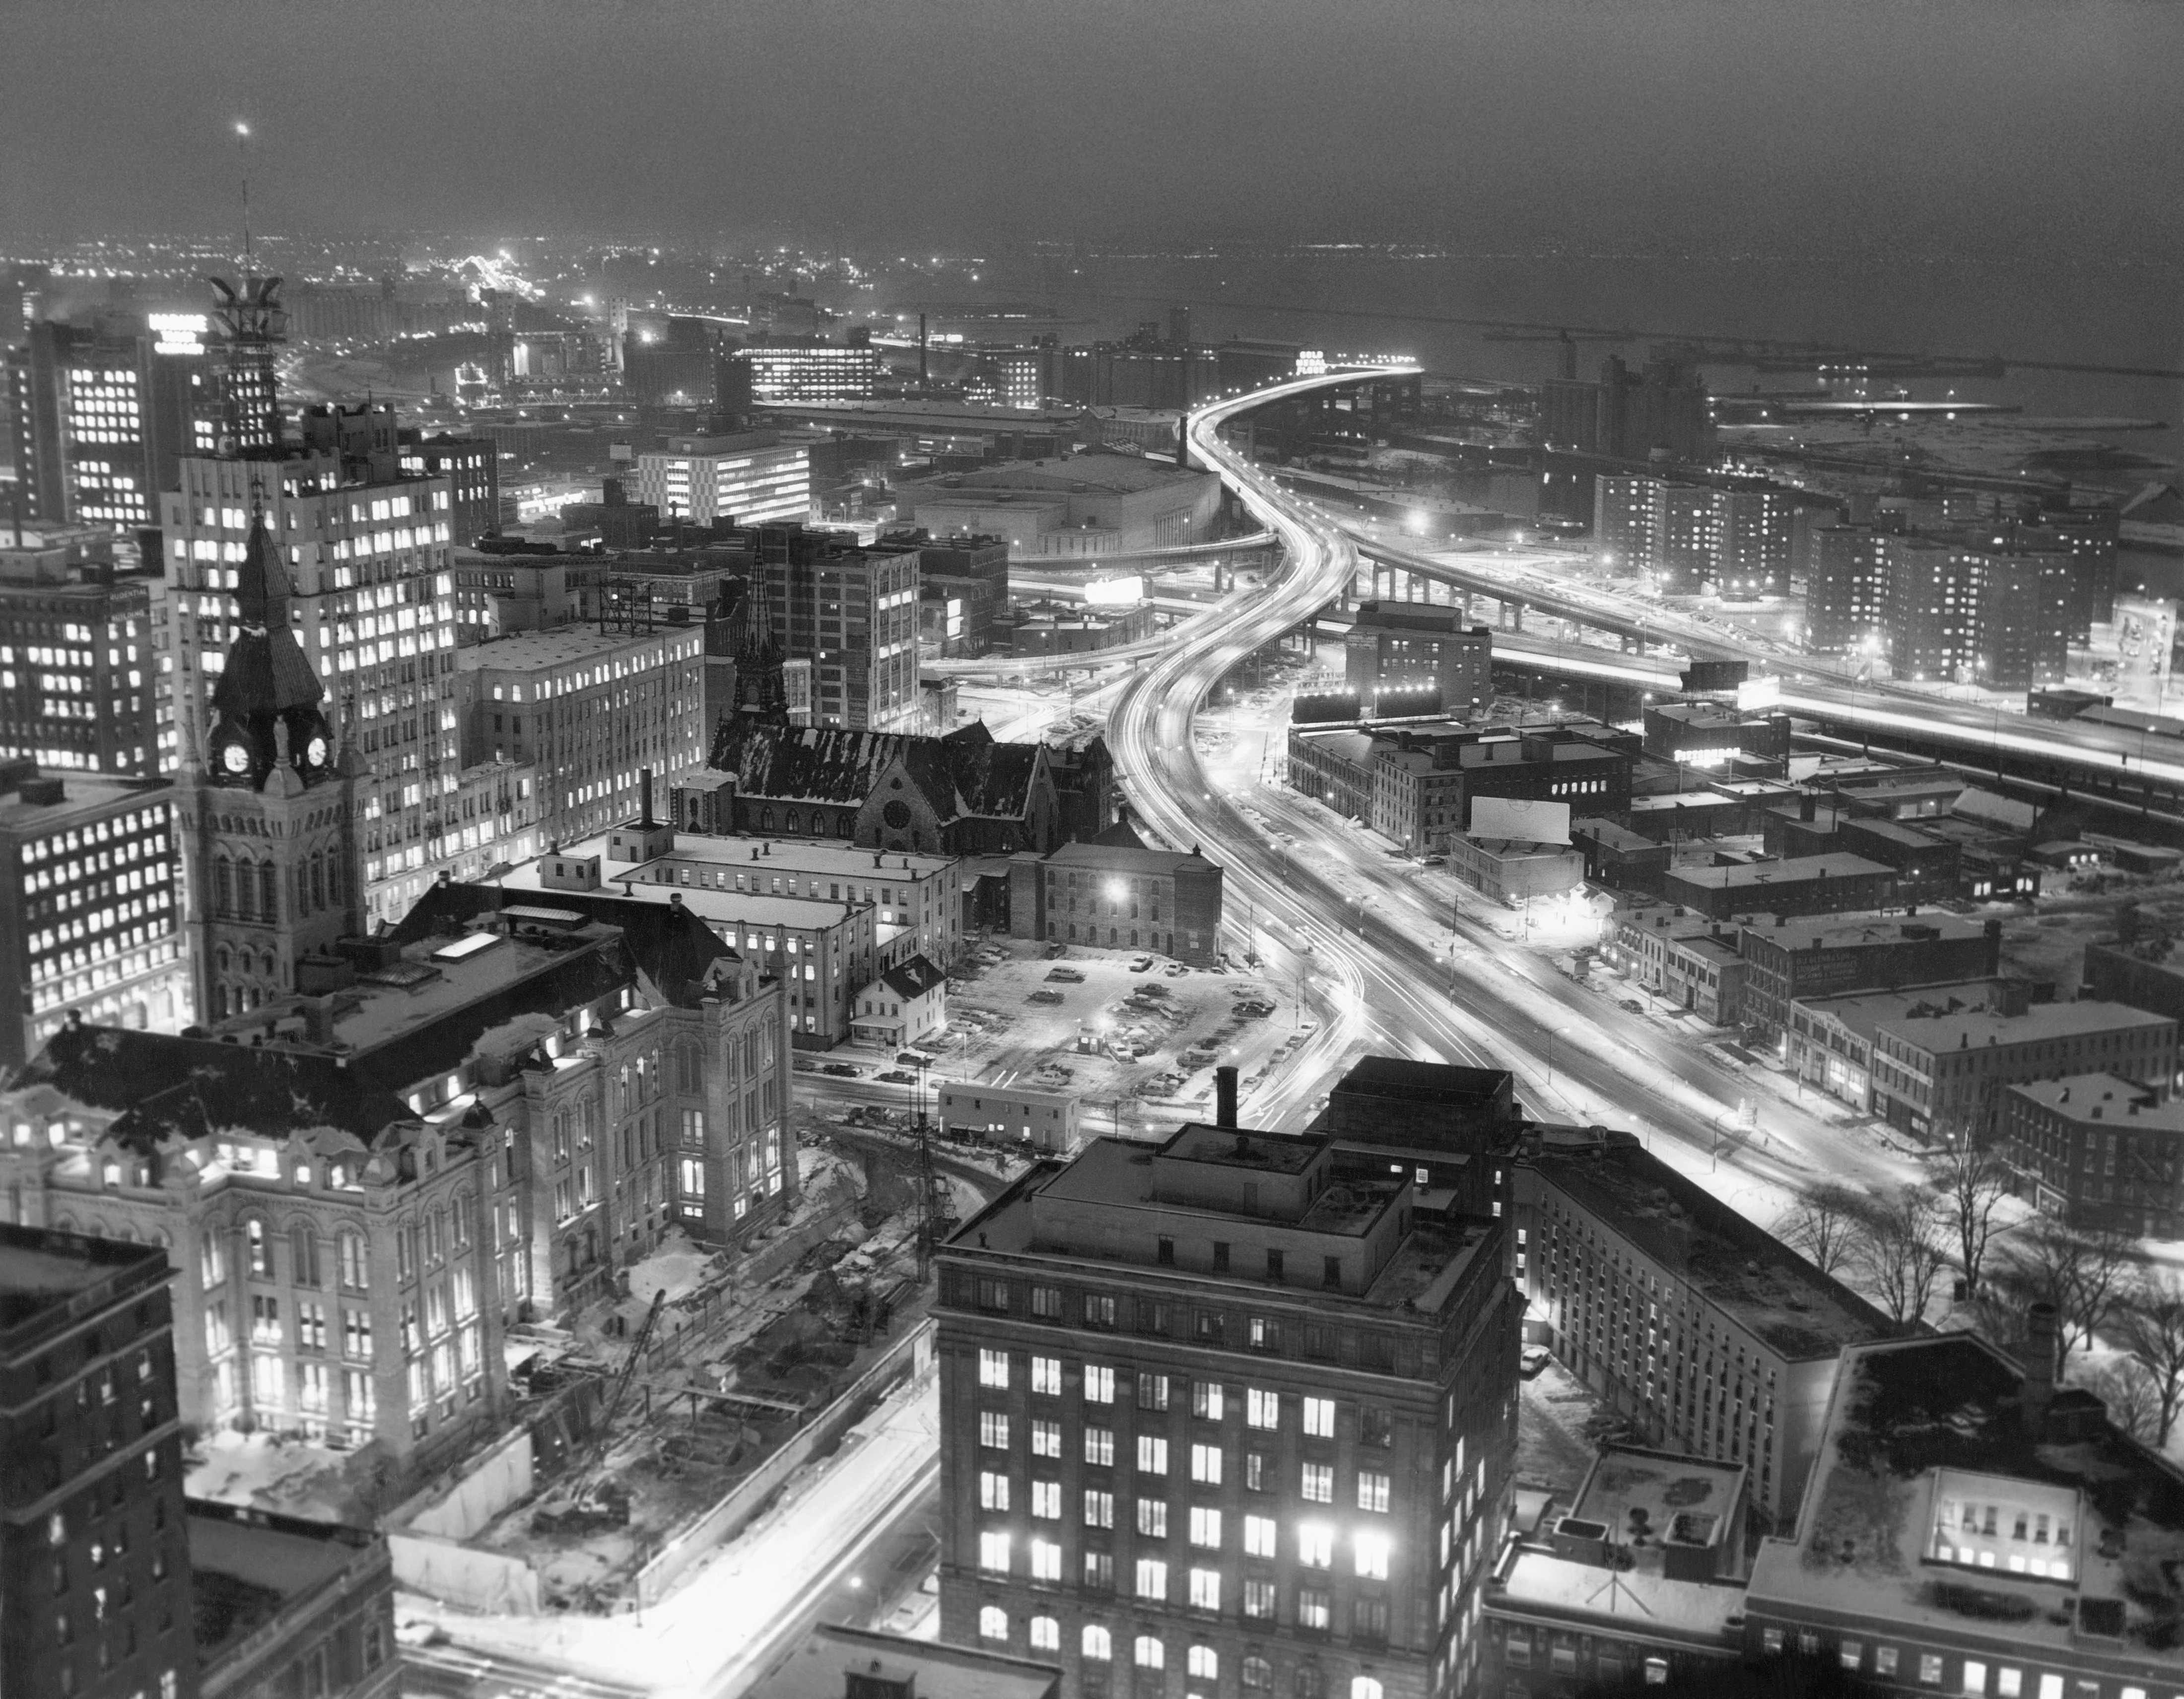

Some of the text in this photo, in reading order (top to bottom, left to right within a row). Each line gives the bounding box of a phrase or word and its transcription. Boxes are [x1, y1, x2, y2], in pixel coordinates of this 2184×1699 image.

[111, 609, 144, 621] BUILDING
[1793, 1005, 1825, 1026] COMMERCIAL
[1827, 1022, 1842, 1034] BLUE
[1843, 1030, 1859, 1044] PRINT
